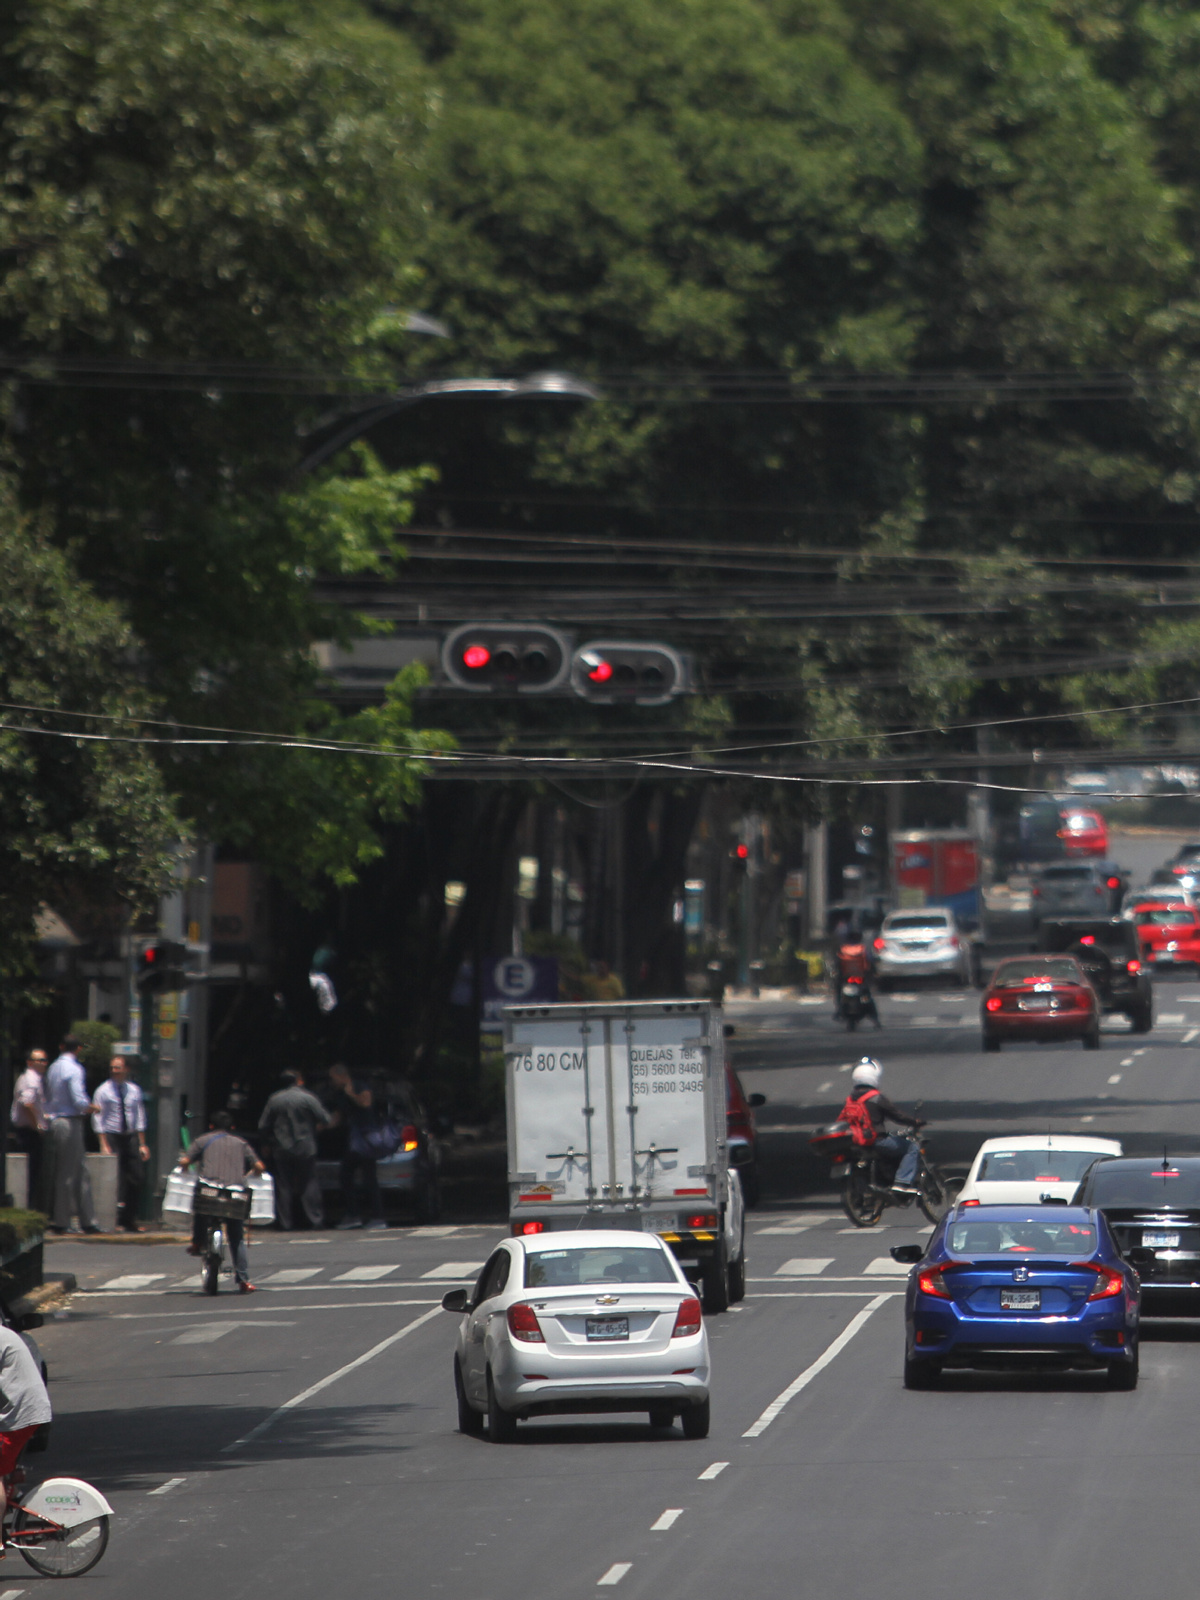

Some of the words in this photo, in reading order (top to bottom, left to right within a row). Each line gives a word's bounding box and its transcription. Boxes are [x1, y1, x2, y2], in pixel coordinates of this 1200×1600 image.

[503, 963, 525, 989] E
[515, 1053, 533, 1072] 76
[536, 1053, 556, 1071] 80
[559, 1052, 586, 1071] CM
[630, 1049, 673, 1062] QUEJAS
[679, 1047, 696, 1060] Tel:
[652, 1063, 676, 1076] 5600
[678, 1062, 703, 1075] 8460
[652, 1081, 676, 1094] 5600
[679, 1080, 704, 1093] 3495
